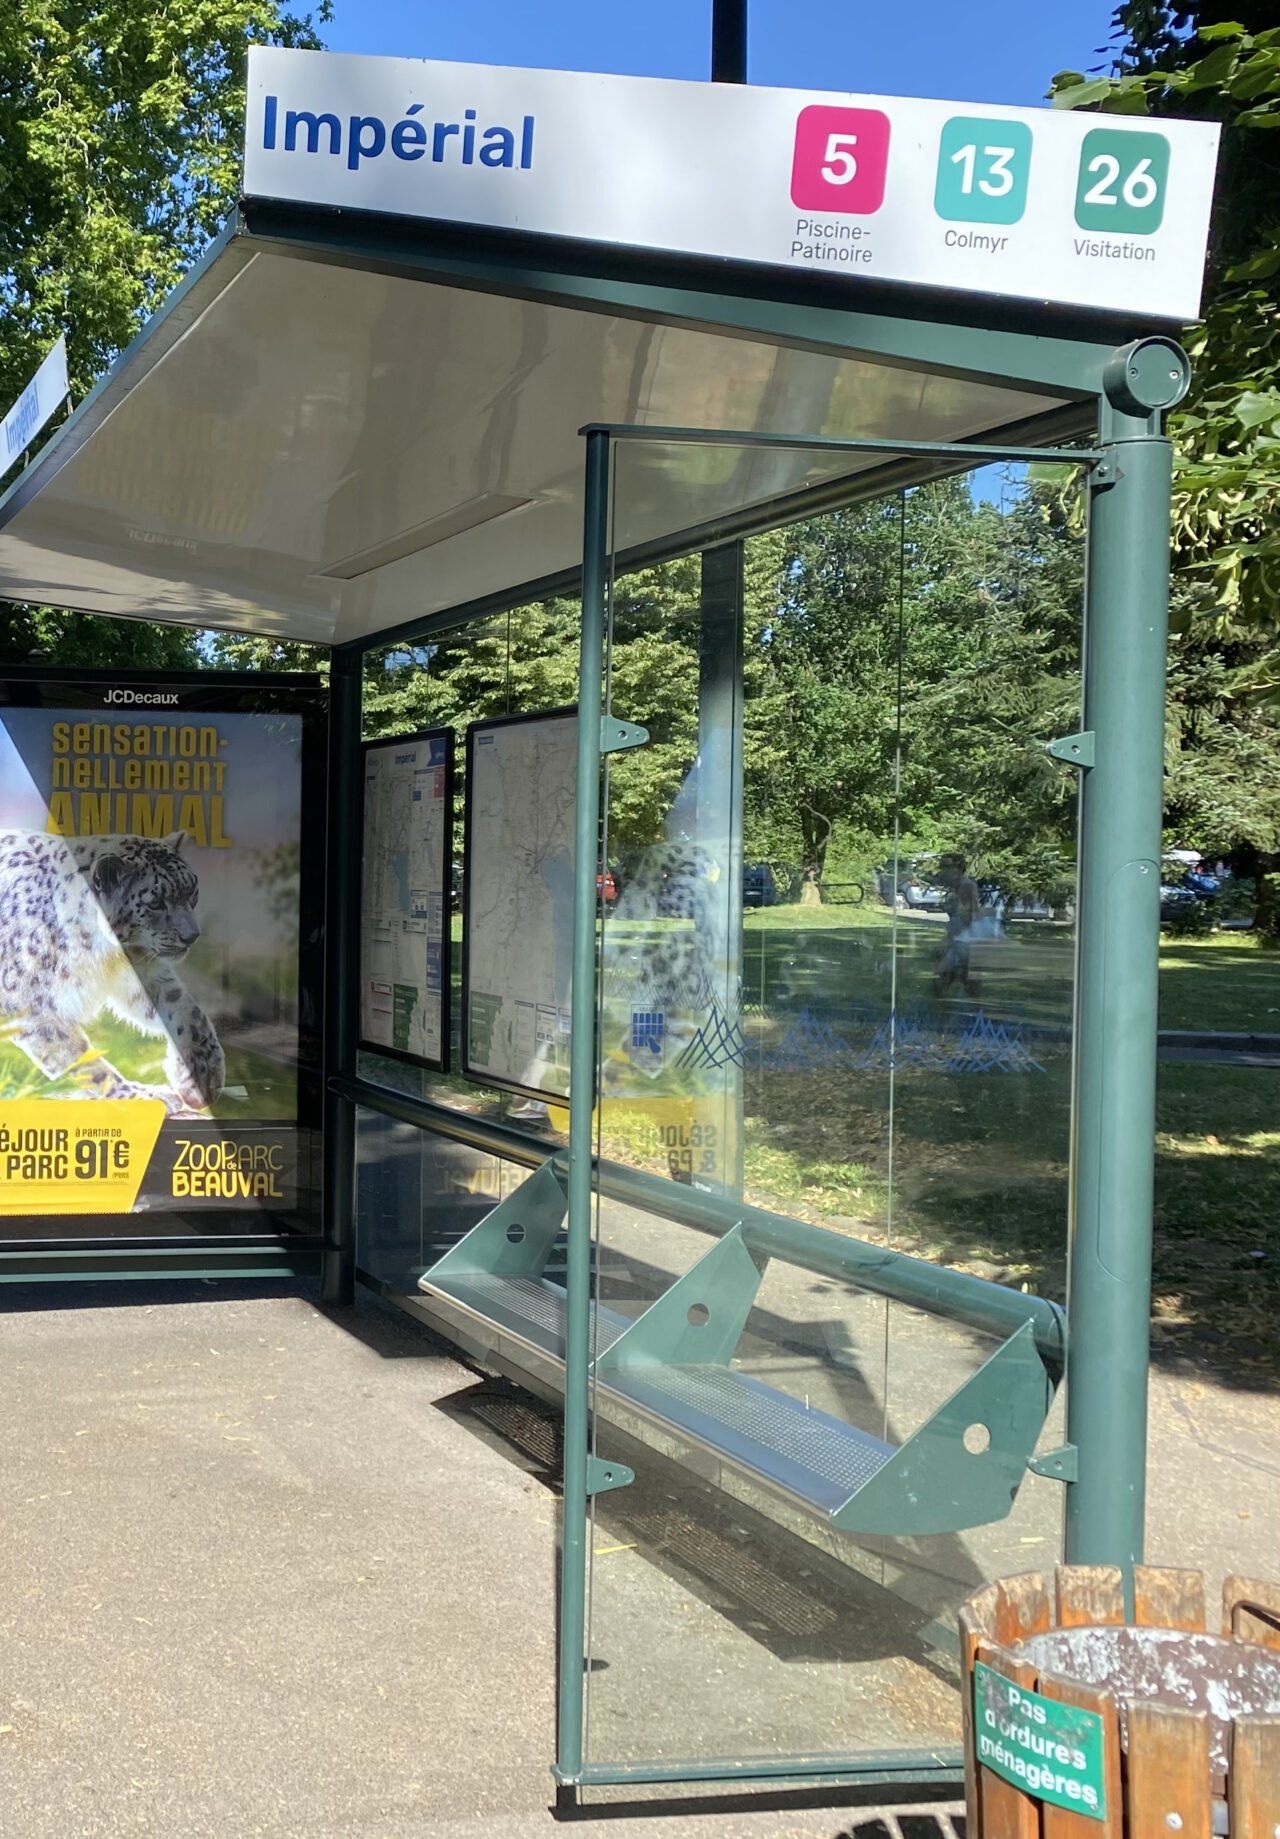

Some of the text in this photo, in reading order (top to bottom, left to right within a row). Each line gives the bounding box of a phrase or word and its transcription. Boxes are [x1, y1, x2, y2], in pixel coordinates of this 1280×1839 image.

[263, 95, 535, 170] Impérial
[821, 133, 858, 186] 5
[950, 144, 1015, 197] 13
[1083, 154, 1158, 208] 26
[790, 241, 872, 264] Patinoire
[796, 218, 871, 241] Piscine-
[944, 229, 1009, 253] Colmyr
[1073, 238, 1156, 262] Visitation
[4, 382, 40, 455] Impérial
[103, 689, 179, 705] JCDecaux
[45, 790, 233, 848] ANIMAL
[172, 1171, 283, 1198] BEAUVAL
[1007, 1685, 1047, 1725] Pas
[980, 1734, 1098, 1805] ménagères
